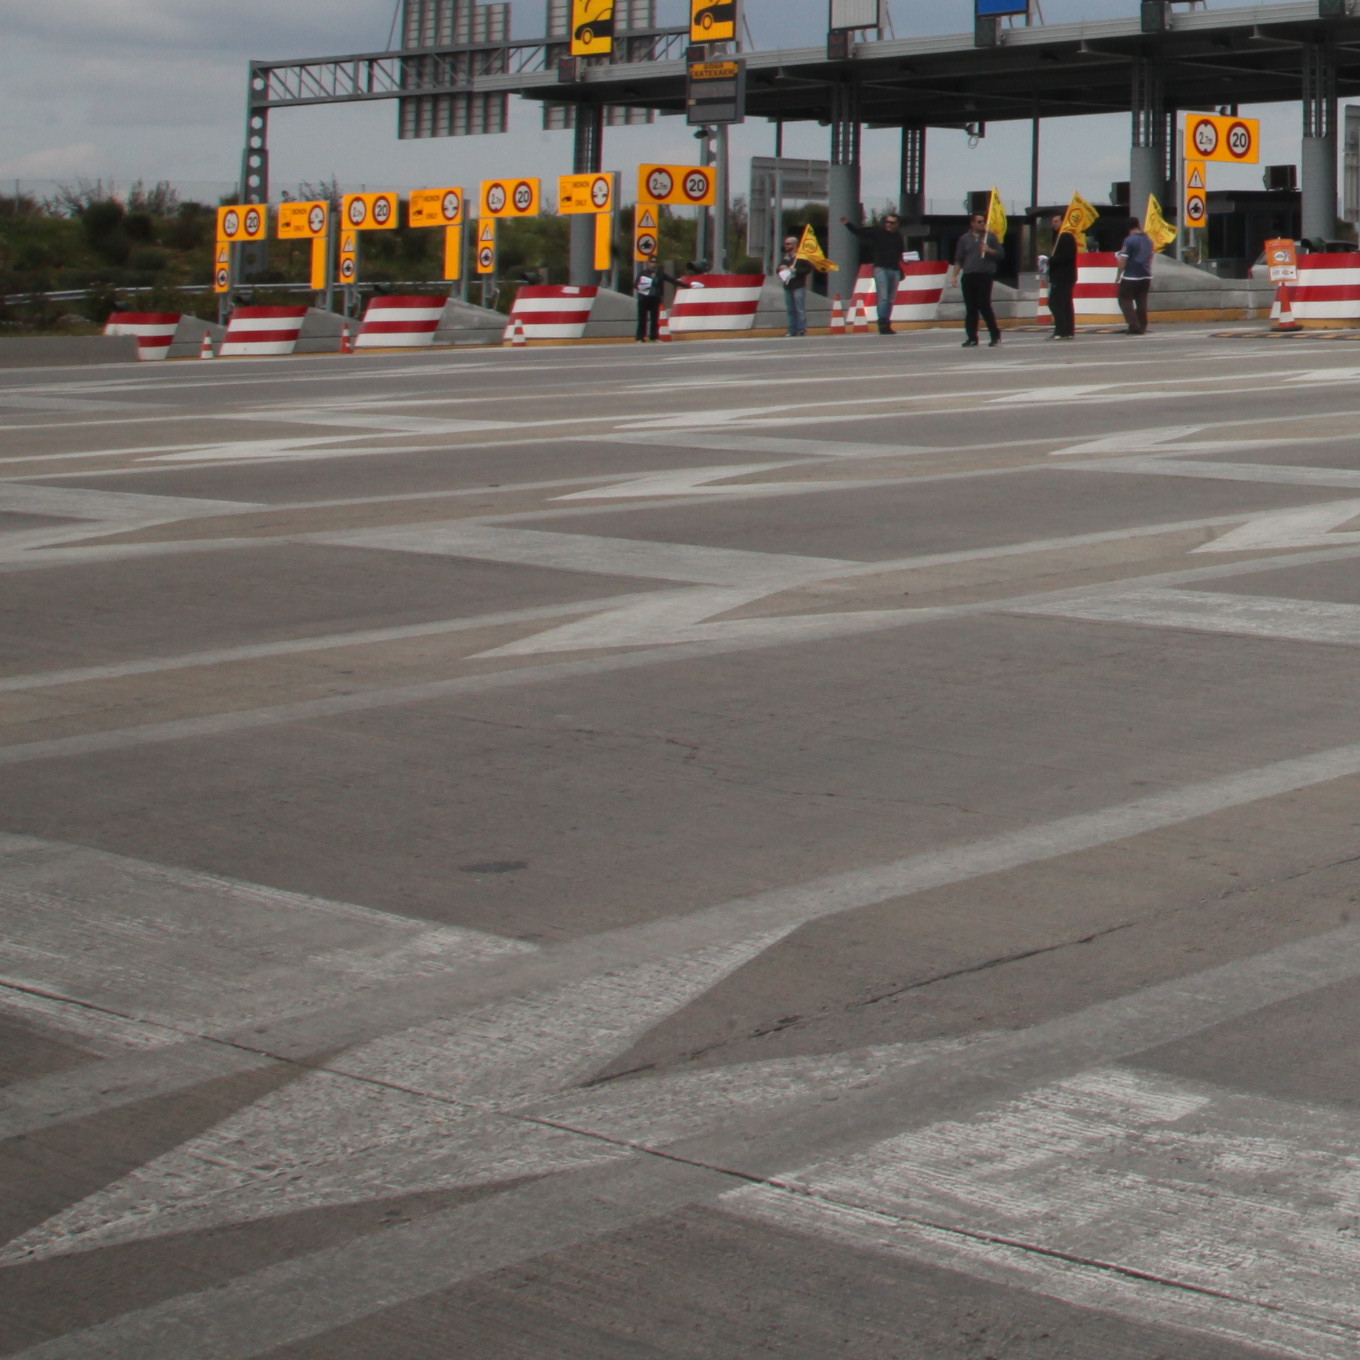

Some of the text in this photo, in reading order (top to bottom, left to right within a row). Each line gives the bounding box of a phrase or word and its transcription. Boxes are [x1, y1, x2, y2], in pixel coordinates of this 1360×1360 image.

[1232, 132, 1247, 148] 20
[688, 179, 705, 192] 20
[517, 191, 530, 203] 20
[376, 204, 387, 217] 20
[248, 216, 258, 229] 20
